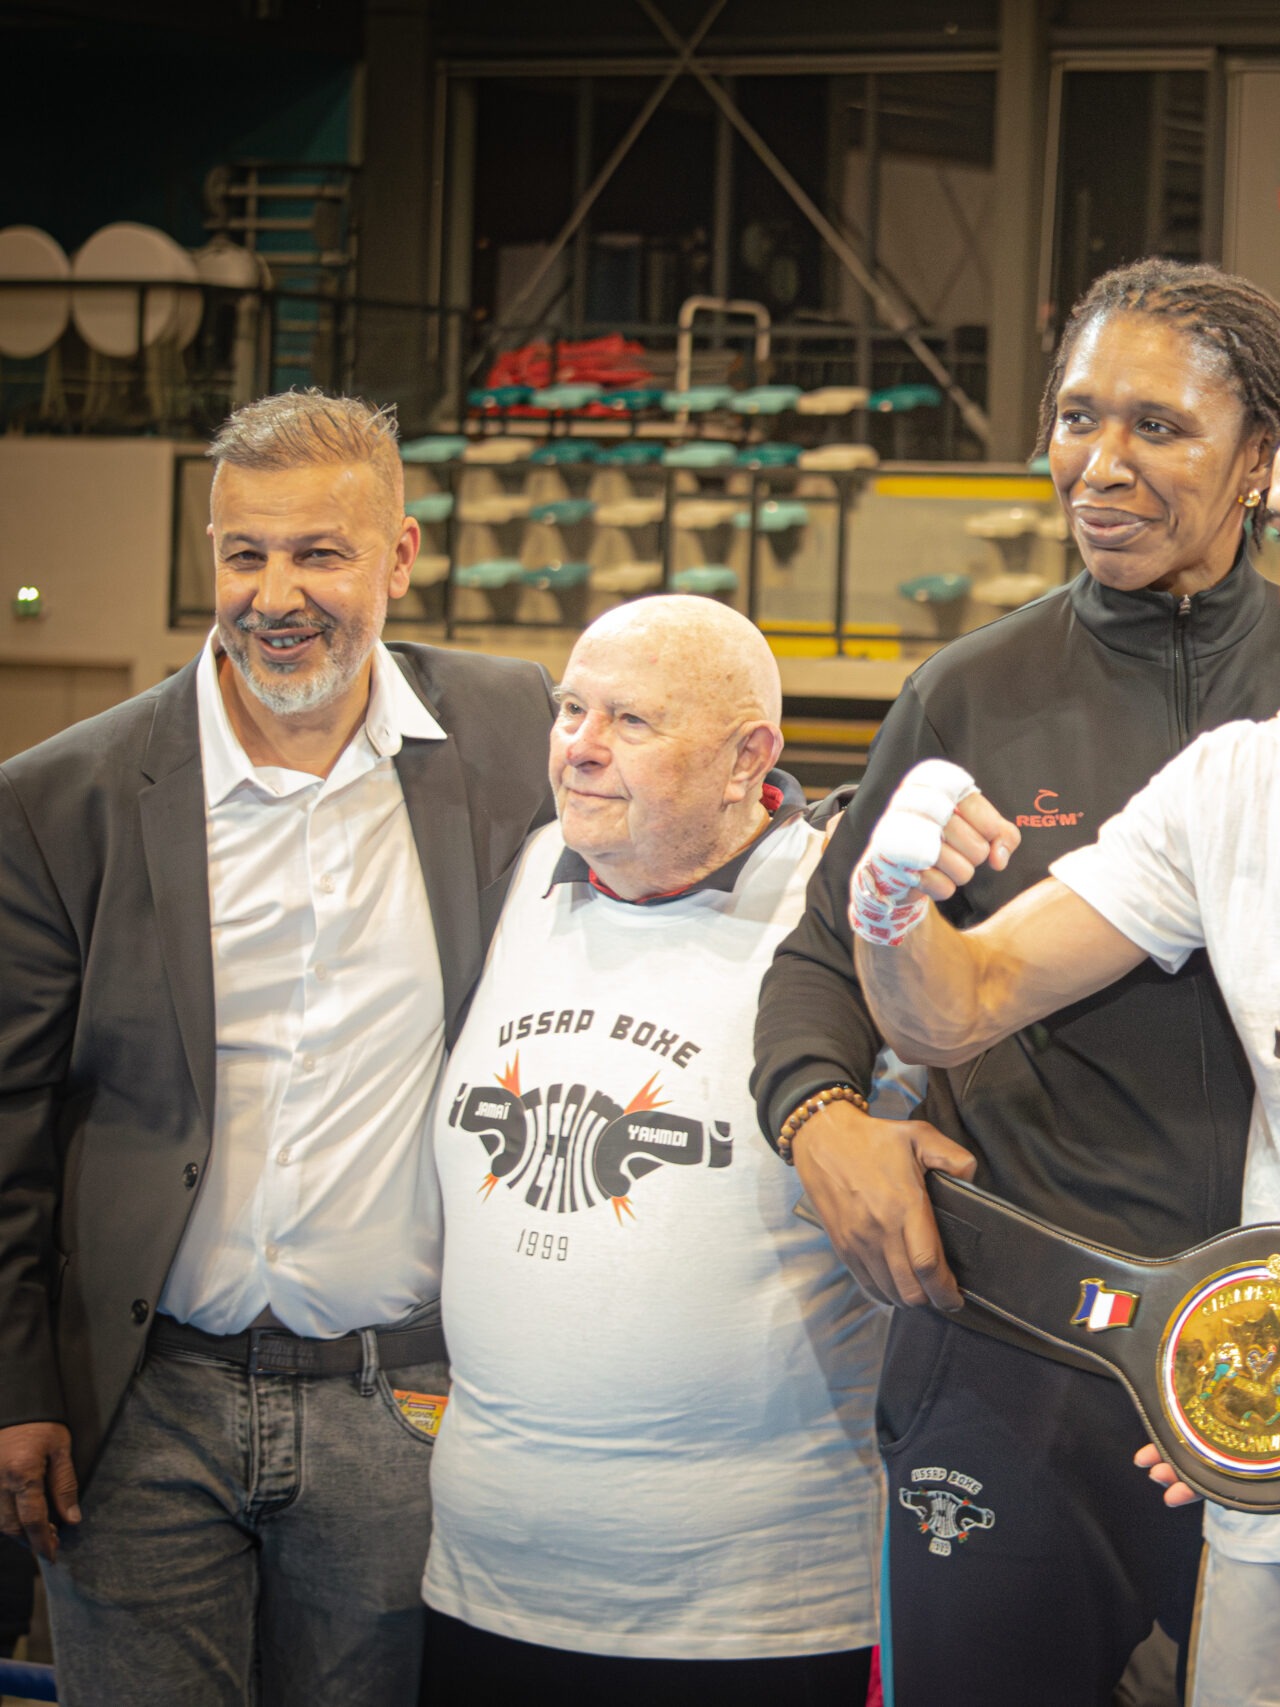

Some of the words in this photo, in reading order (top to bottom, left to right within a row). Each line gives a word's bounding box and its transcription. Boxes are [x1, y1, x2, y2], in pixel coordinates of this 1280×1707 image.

[498, 1009, 595, 1048] USSAP
[609, 1014, 702, 1069] BOXE
[474, 1101, 512, 1121] JAMAÏ
[516, 1228, 569, 1261] 1999
